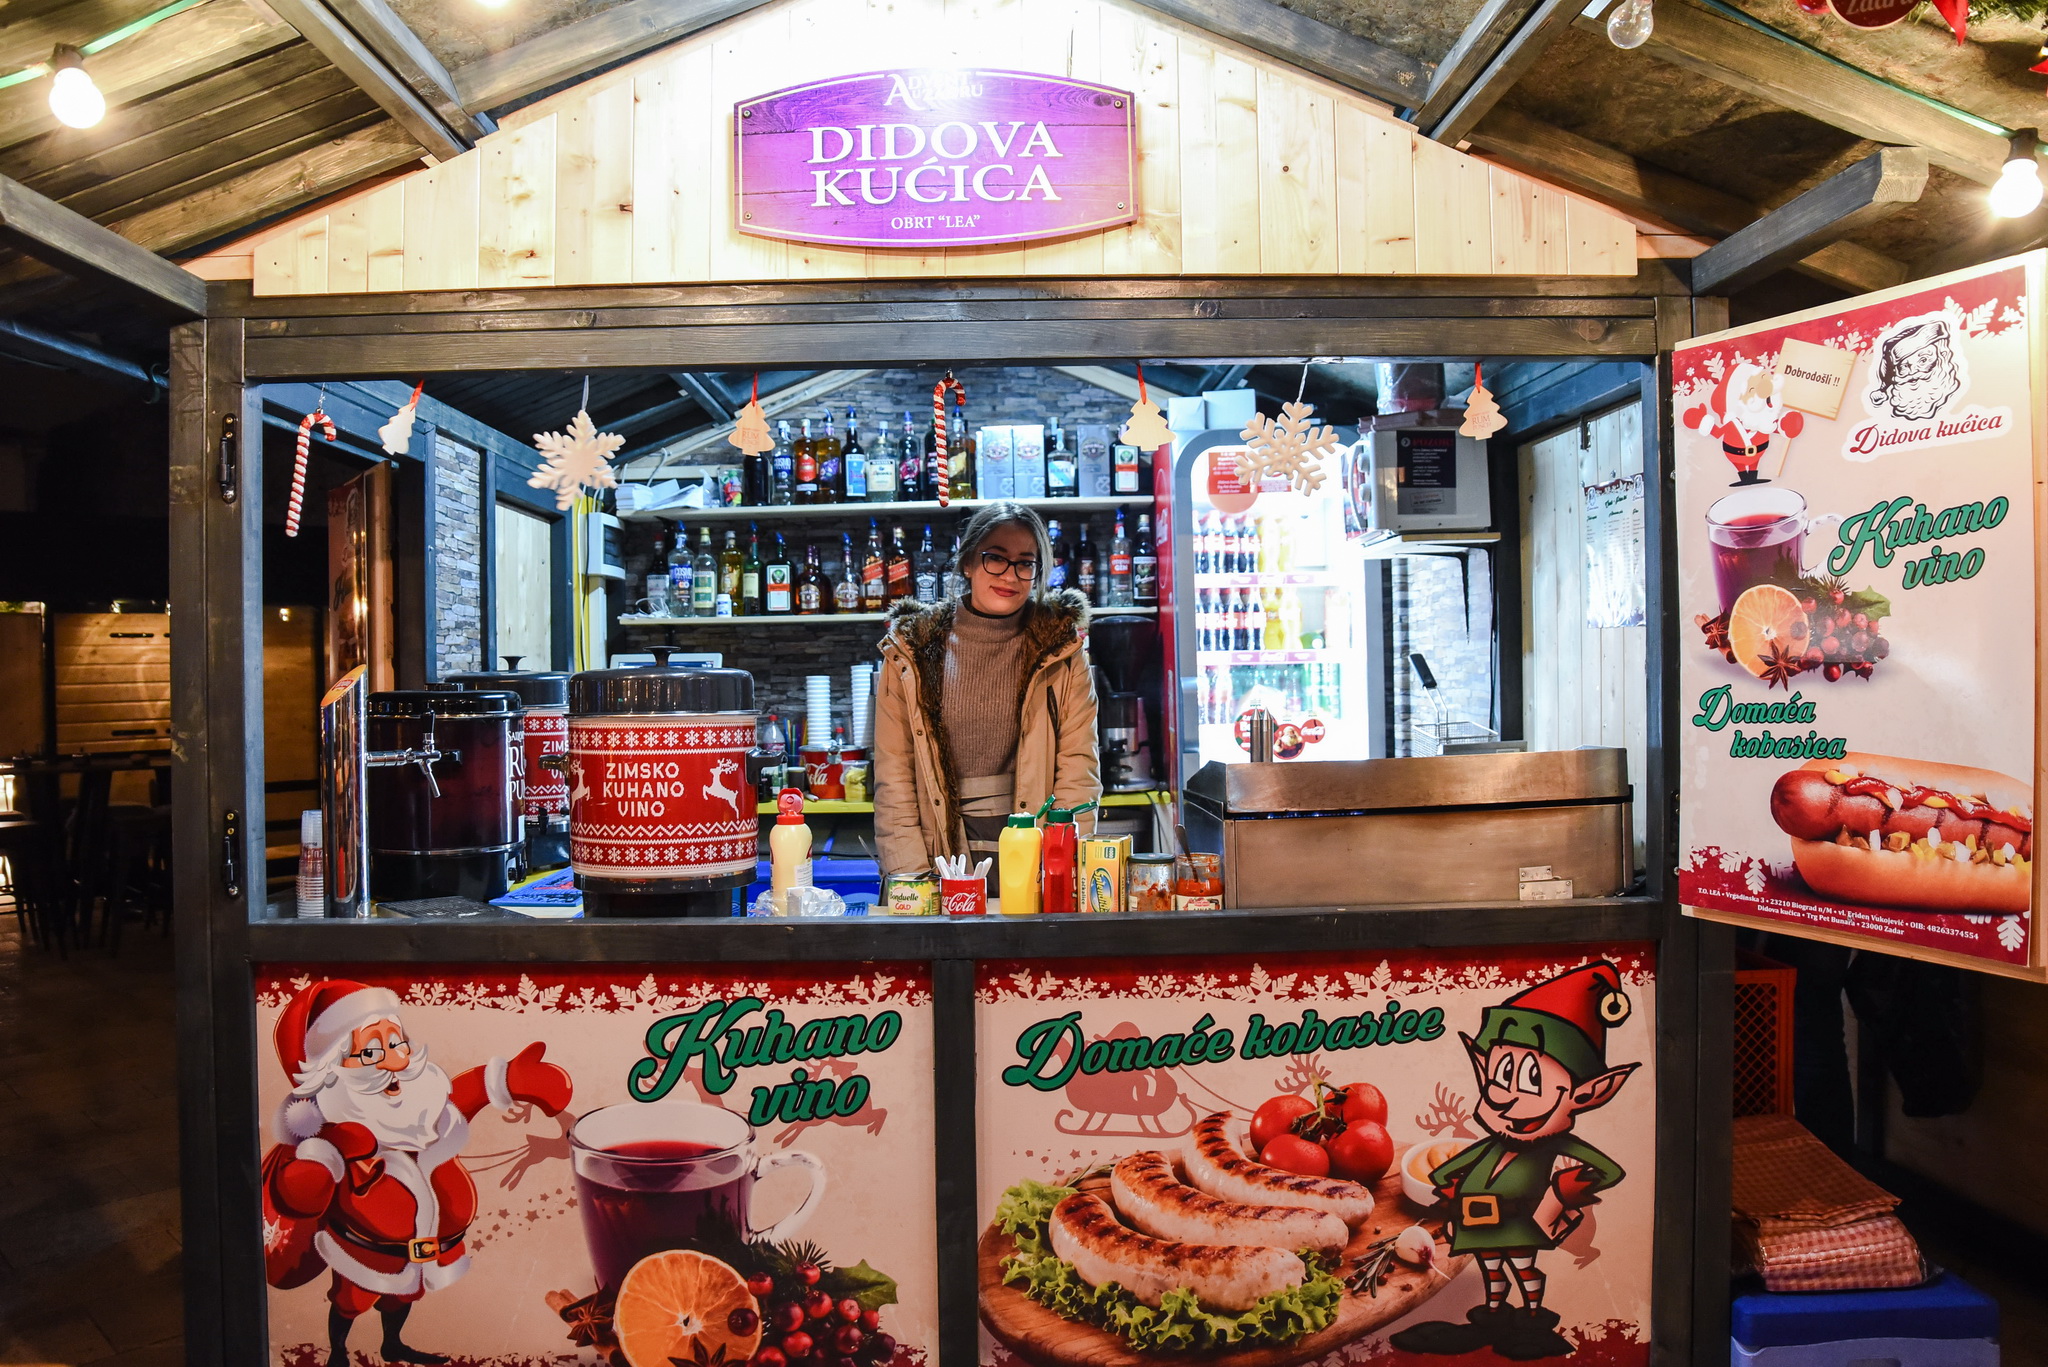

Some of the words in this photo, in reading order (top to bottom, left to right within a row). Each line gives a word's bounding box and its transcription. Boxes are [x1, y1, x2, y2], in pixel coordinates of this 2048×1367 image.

[806, 120, 1063, 164] DIDOVA
[810, 157, 1063, 208] KUĆICA
[890, 216, 934, 230] OBRT
[1783, 363, 1832, 386] Dobrodošli
[1850, 423, 1931, 454] Didova
[1936, 413, 2003, 437] kućica
[1827, 495, 2010, 577] Kuhano
[1902, 545, 1986, 590] vino
[1692, 684, 1817, 732] Domaća
[1730, 730, 1847, 760] kobasica
[602, 780, 685, 799] KUHANO
[605, 761, 680, 780] ZIMSKO
[617, 800, 666, 818] VINO
[1709, 889, 1721, 897] LEA
[1725, 892, 1761, 904] Vrgadinska
[1769, 899, 1791, 908] 23210
[1791, 901, 1818, 913] Biograd
[1818, 905, 1833, 915] n/M
[1870, 914, 1905, 927] Vukojević
[1909, 921, 1926, 931] OIB:
[1926, 922, 1980, 940] 48263374554
[1757, 904, 1780, 914] Didova
[1780, 907, 1801, 918] kućica
[1805, 912, 1818, 922] Trg
[1818, 914, 1830, 923] Pet
[1861, 921, 1883, 932] 23000
[1883, 925, 1905, 936] Zadar
[627, 996, 903, 1103] Kuhano
[1001, 1010, 1235, 1092] Domaće
[1239, 1000, 1446, 1061] kobasice
[749, 1067, 871, 1127] vino
